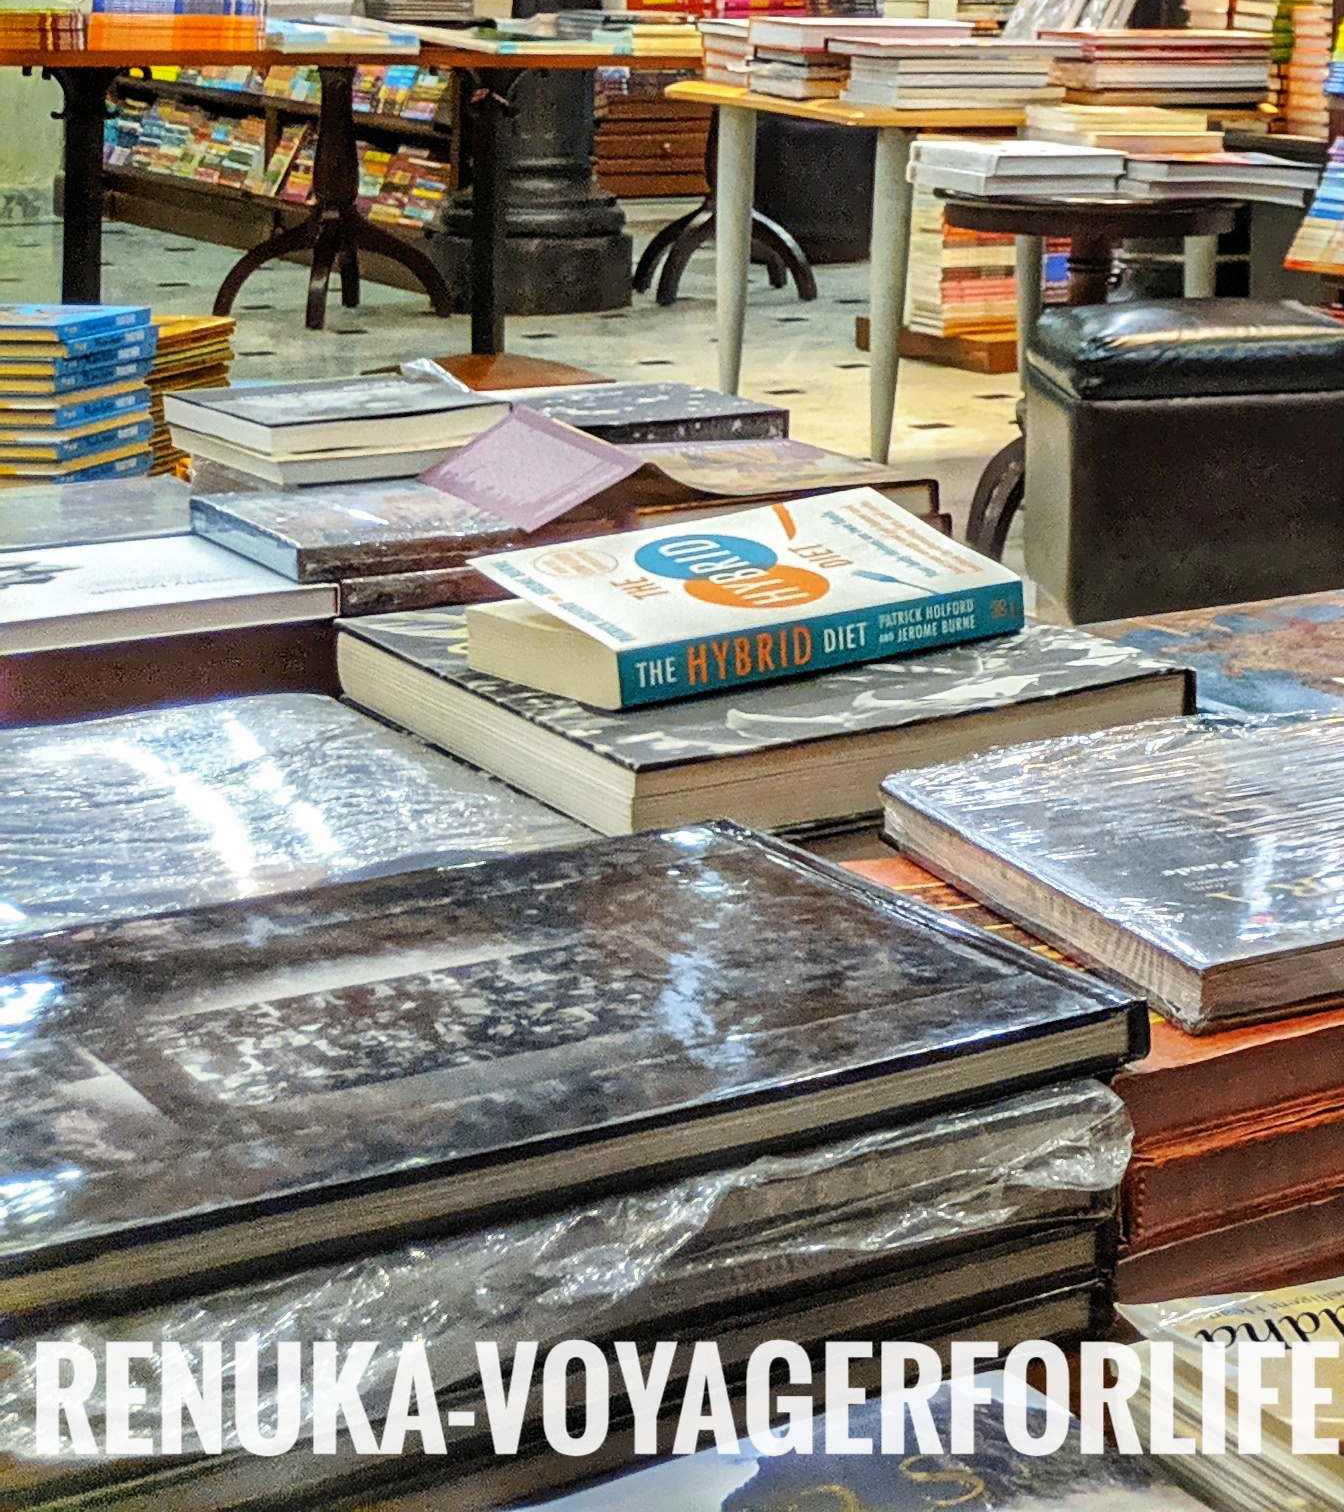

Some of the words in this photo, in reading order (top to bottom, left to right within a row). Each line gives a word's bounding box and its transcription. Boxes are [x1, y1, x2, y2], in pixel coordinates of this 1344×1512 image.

[609, 574, 670, 602] THE
[656, 538, 811, 609] HYBRID
[788, 542, 855, 570] DIET
[878, 604, 924, 630] PATRICK
[925, 598, 975, 623] HOLFORD
[896, 621, 939, 642] JEROME
[940, 614, 976, 634] BURNE
[635, 656, 677, 689] THE
[686, 626, 814, 685] HYBRID
[823, 622, 868, 654] DIET
